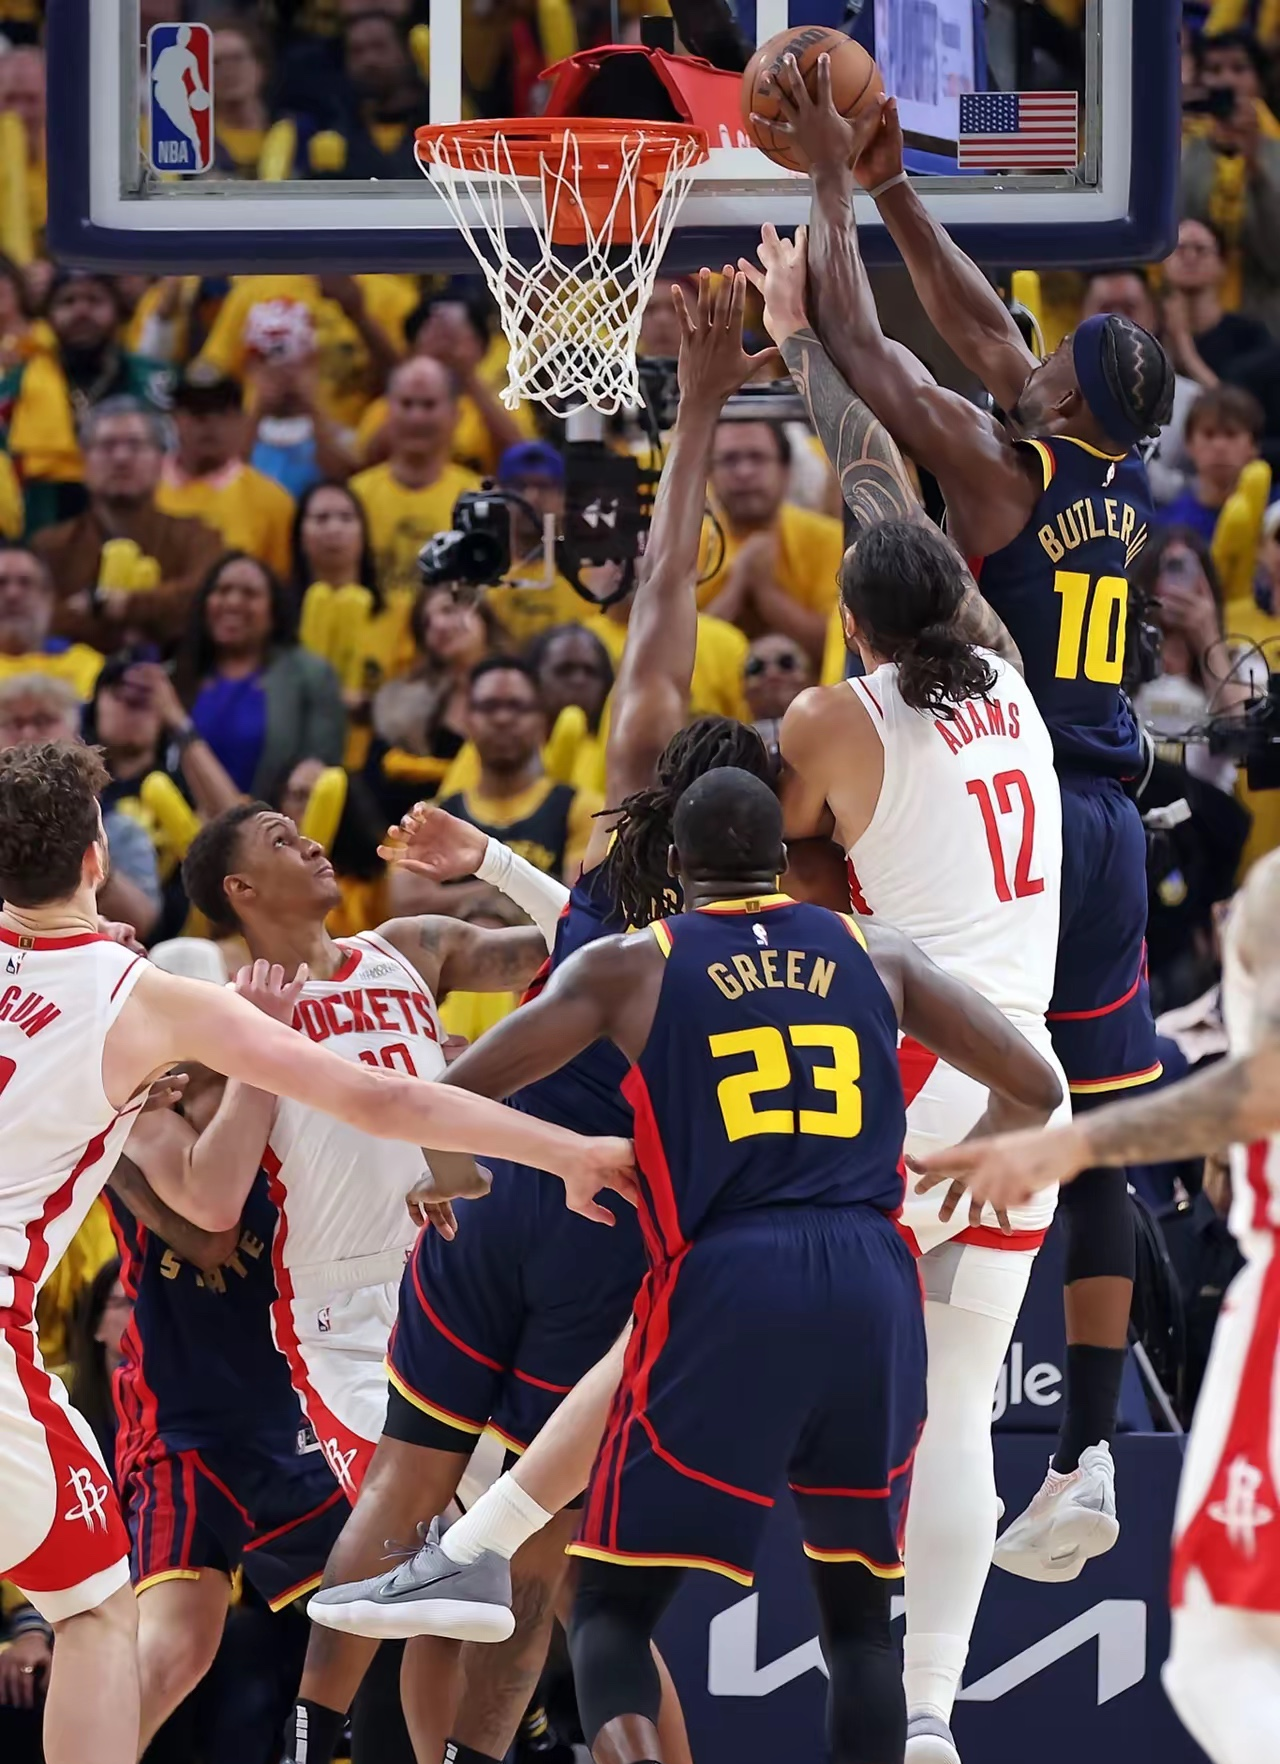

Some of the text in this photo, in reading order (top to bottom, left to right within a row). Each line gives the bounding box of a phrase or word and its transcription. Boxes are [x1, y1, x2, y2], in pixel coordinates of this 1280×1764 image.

[158, 140, 189, 164] NBA
[1037, 497, 1136, 564] BUTLER
[1053, 570, 1129, 685] 10
[933, 698, 1021, 756] ADAMS
[965, 768, 1045, 903] 12
[706, 949, 837, 1001] GREEN
[291, 988, 438, 1043] OCKETS
[708, 1023, 863, 1143] 23
[159, 1229, 265, 1294] SATE
